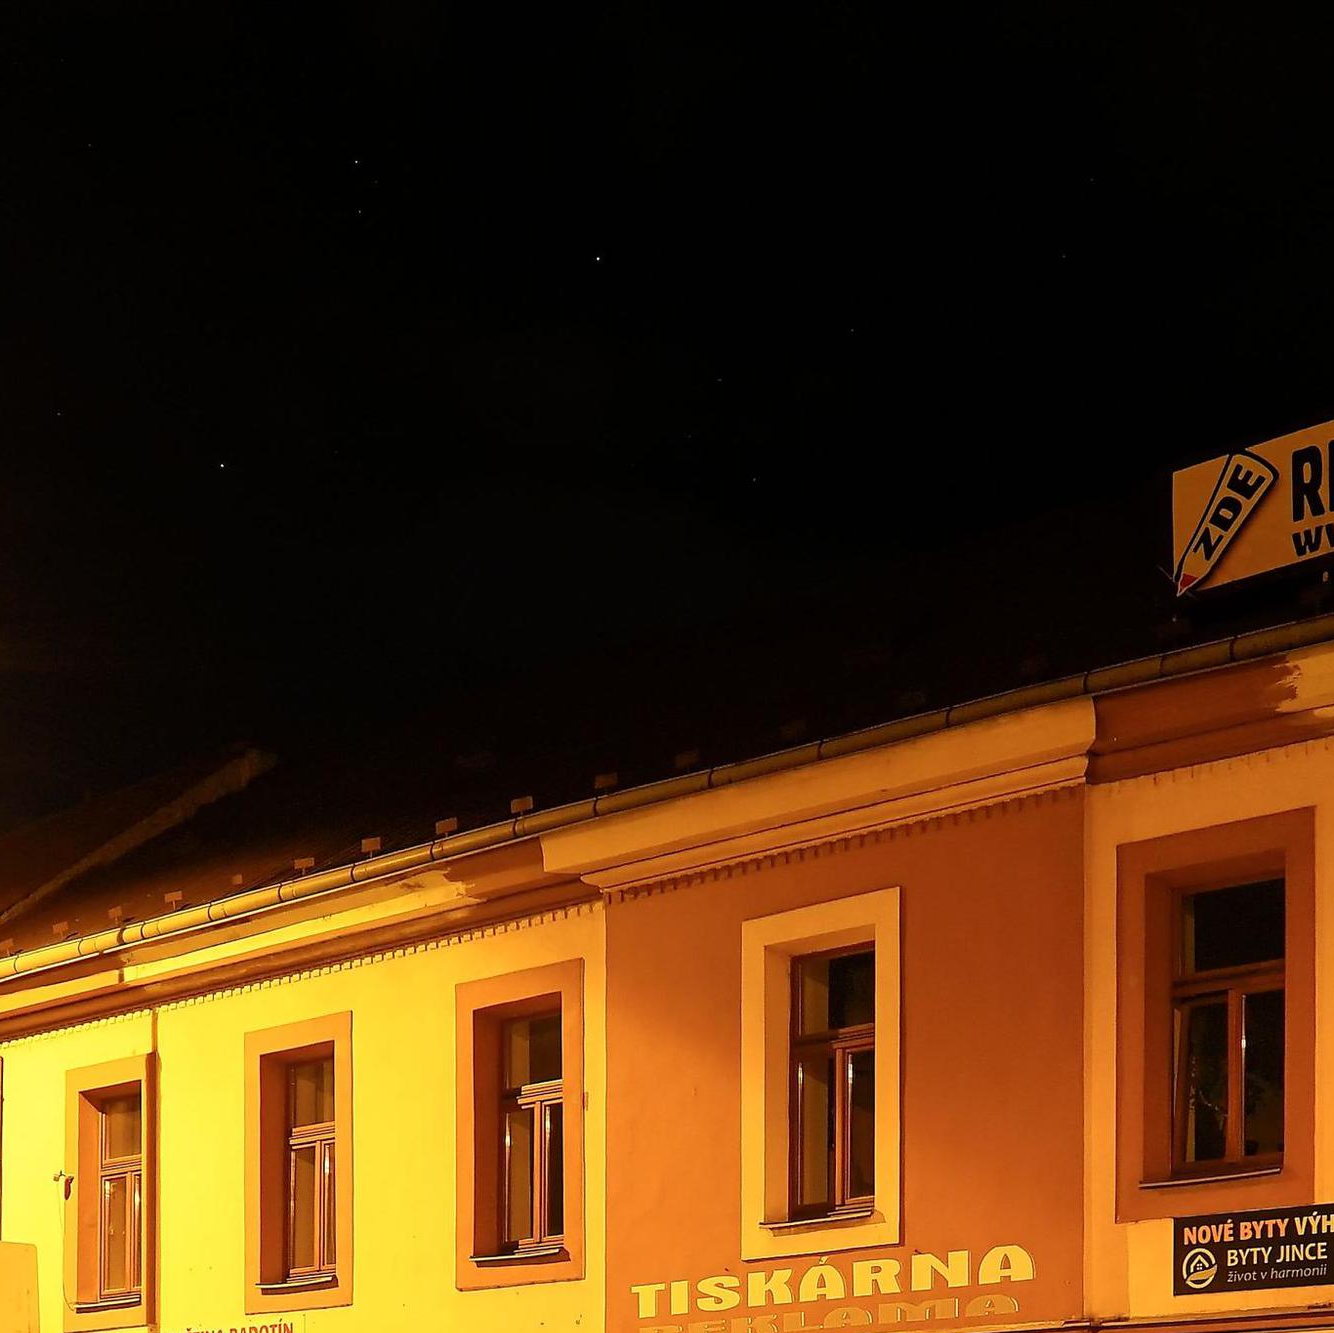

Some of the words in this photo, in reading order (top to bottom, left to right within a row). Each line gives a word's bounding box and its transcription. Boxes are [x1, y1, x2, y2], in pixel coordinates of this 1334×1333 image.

[1194, 462, 1267, 562] ZDE
[1183, 1219, 1234, 1246] NOVÉ
[1239, 1216, 1289, 1241] BYTY
[1226, 1245, 1270, 1267] BYTY
[1275, 1242, 1327, 1263] JINCE
[630, 1244, 1037, 1318] TISKÁRNA
[1226, 1268, 1257, 1283] život
[1260, 1271, 1267, 1279] v
[1270, 1264, 1327, 1279] harmonii
